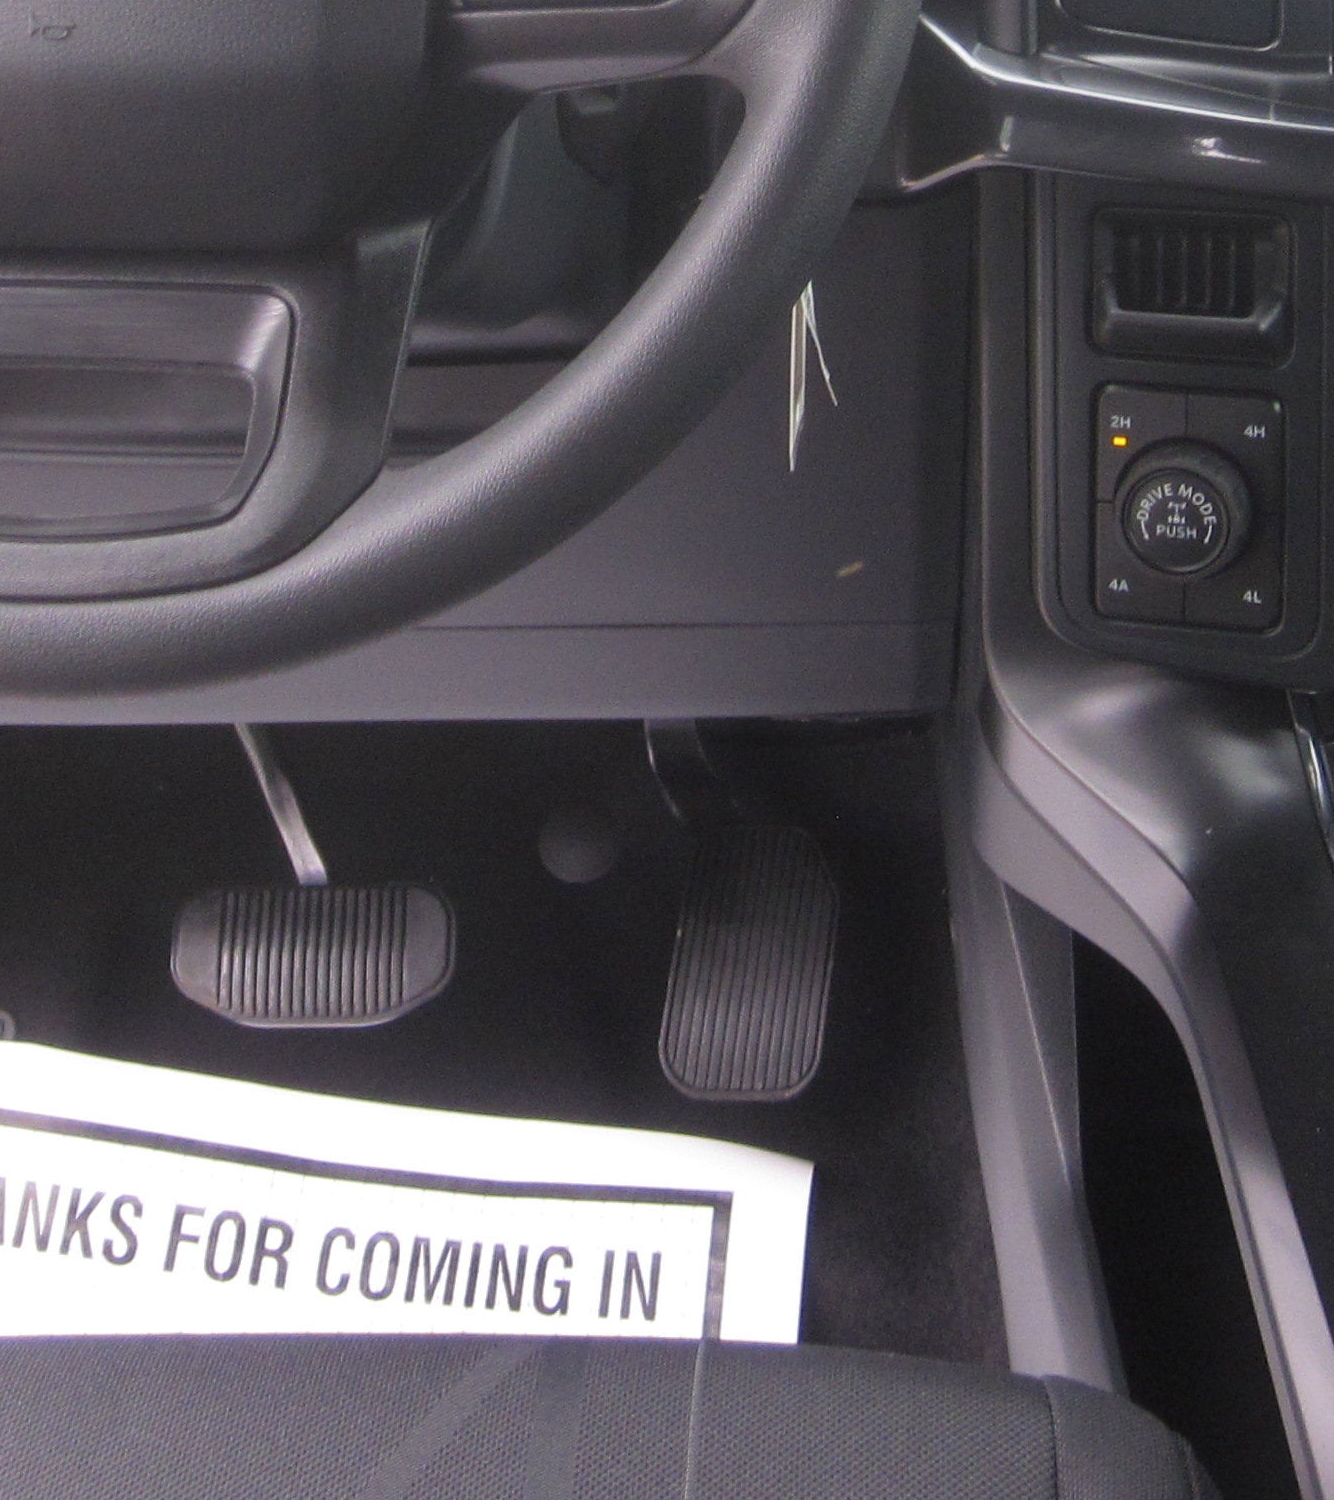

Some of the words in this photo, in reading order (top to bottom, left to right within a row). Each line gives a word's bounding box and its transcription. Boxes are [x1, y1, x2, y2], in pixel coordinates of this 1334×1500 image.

[1110, 415, 1131, 429] 2H
[1243, 425, 1265, 439] 4H
[1137, 482, 1173, 523] DRIVE
[1177, 483, 1218, 526] MODE
[1156, 525, 1197, 540] PUSH
[1108, 579, 1129, 593] 4A
[1242, 590, 1262, 605] 4L
[161, 1202, 295, 1292] FOR
[316, 1226, 574, 1318] COMING
[598, 1247, 663, 1324] IN
